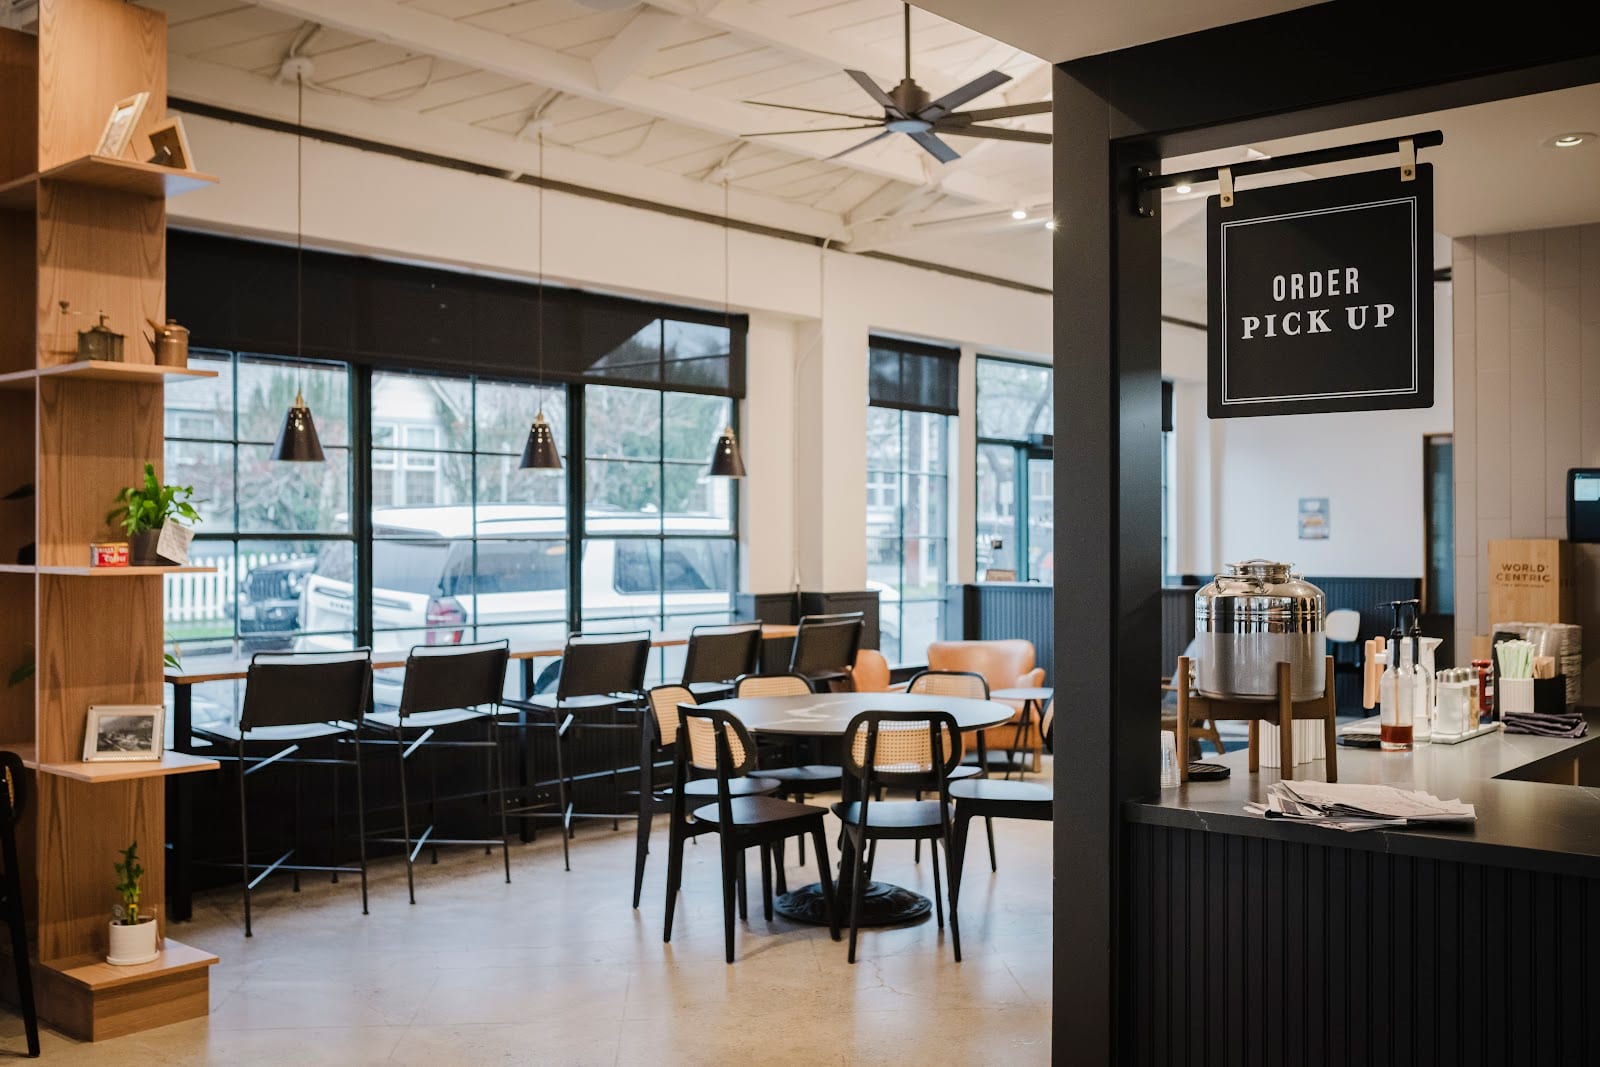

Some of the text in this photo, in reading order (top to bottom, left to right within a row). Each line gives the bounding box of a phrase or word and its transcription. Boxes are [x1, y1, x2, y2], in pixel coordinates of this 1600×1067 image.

[1272, 267, 1359, 301] ORDER
[1241, 303, 1395, 339] PICK UP
[1496, 573, 1550, 582] CENTRIC
[1502, 563, 1545, 572] WORLD
